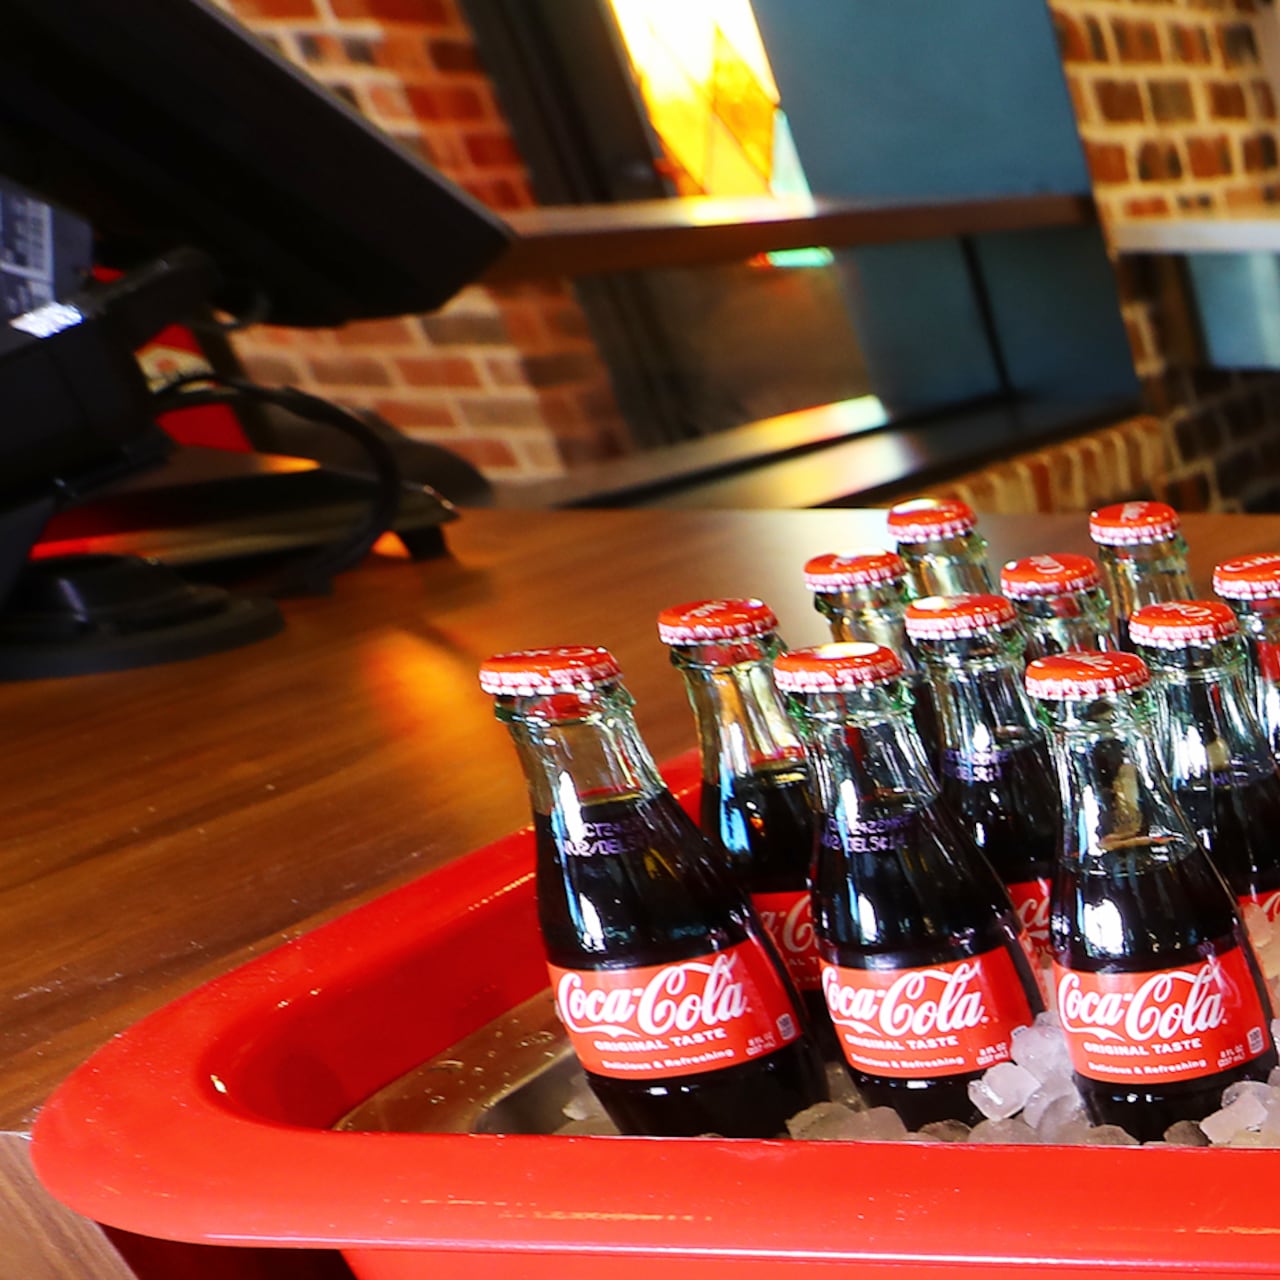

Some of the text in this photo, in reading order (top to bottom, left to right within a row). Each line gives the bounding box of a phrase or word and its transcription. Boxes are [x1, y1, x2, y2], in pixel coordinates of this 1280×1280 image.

[558, 952, 747, 1037] Coca-Cola
[822, 960, 989, 1037] Coca-Cola
[1058, 962, 1227, 1042] Coca-Cola
[670, 1028, 727, 1047] TASTE
[907, 1035, 959, 1050] TASTE
[1083, 1038, 1202, 1056] ORIGINAL TASTE
[1144, 1058, 1207, 1075] Refreshing
